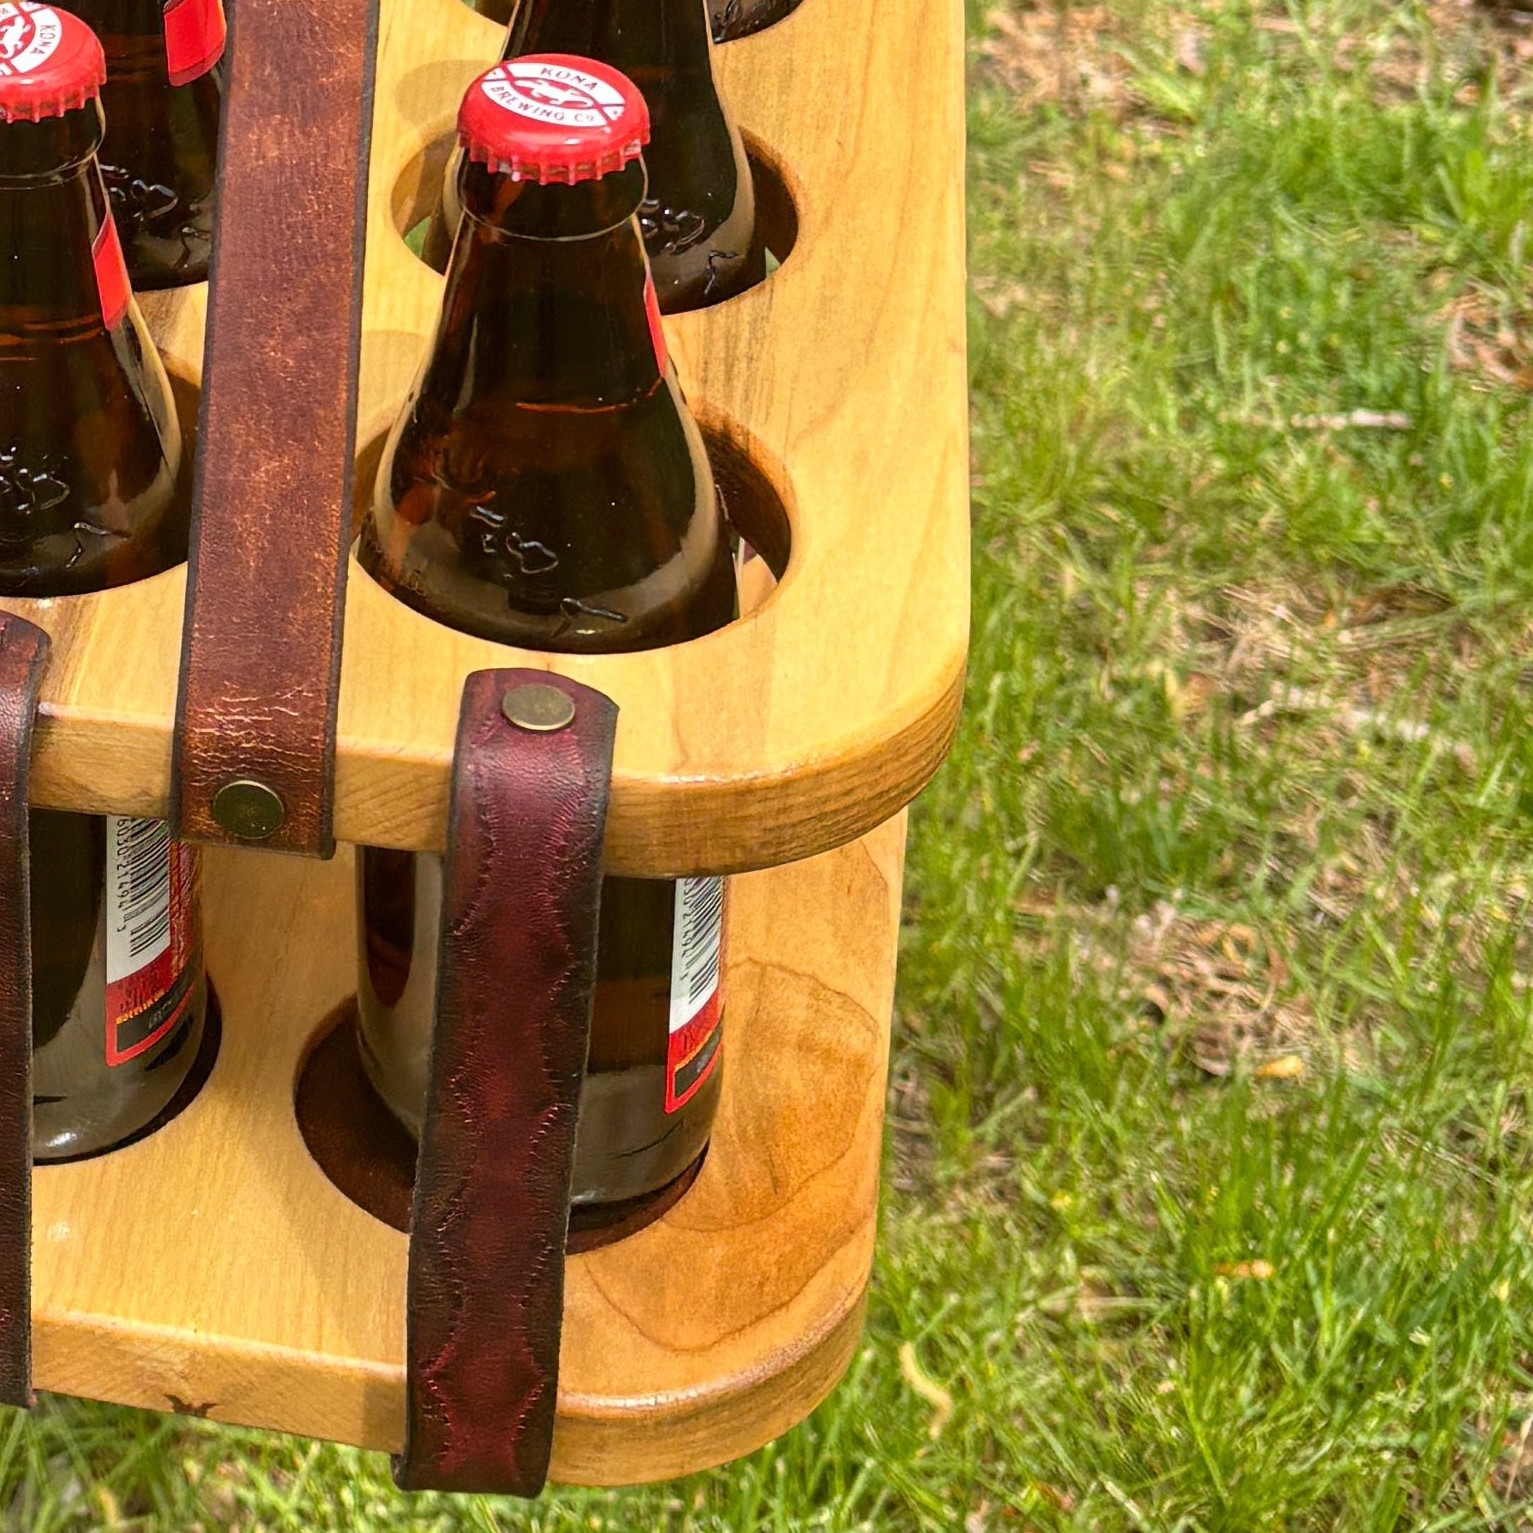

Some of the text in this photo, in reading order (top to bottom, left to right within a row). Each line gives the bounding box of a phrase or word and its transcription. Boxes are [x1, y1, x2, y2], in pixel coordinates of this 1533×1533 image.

[29, 23, 57, 56] KONA
[539, 66, 599, 93] KONA
[490, 85, 565, 122] BREWING
